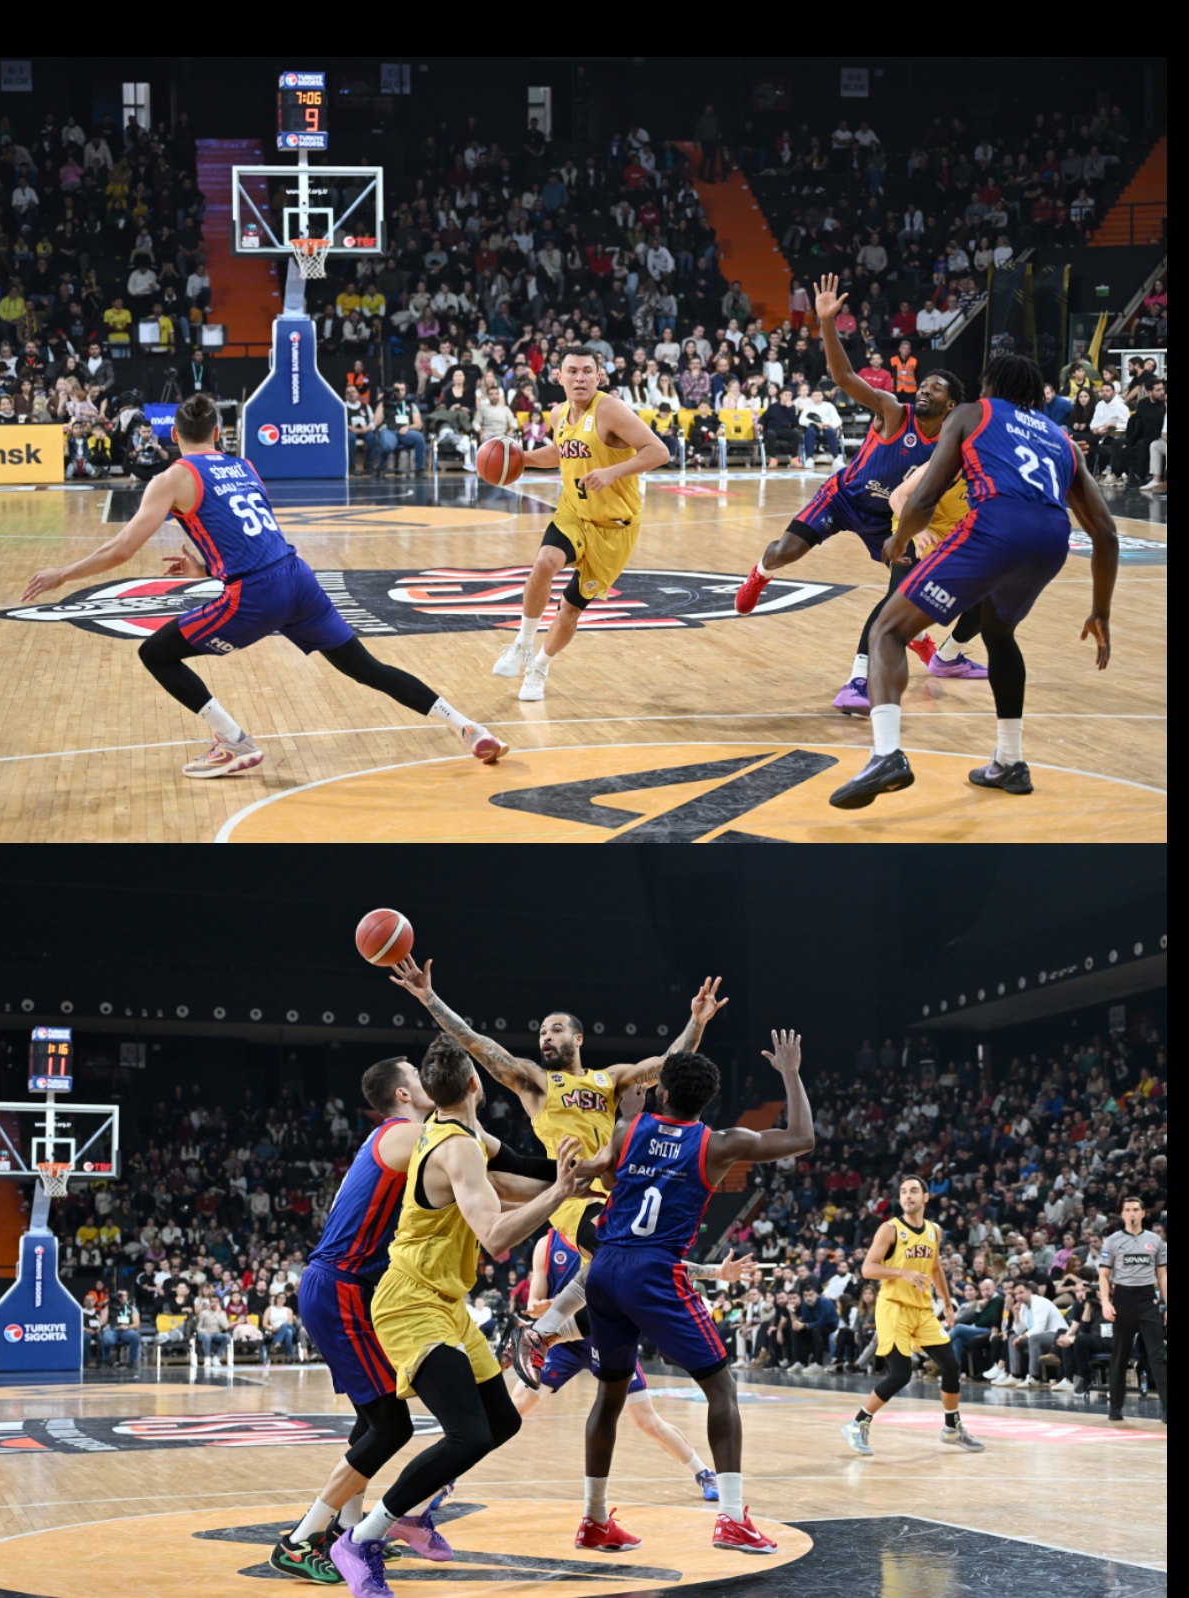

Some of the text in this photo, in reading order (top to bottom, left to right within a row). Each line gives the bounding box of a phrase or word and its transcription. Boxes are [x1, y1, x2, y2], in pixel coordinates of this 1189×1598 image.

[296, 91, 322, 105] 7:06
[305, 108, 319, 132] 9
[1005, 423, 1031, 440] BAU
[559, 439, 591, 459] MSK
[1014, 445, 1060, 501] 21
[213, 483, 237, 497] BAU
[228, 492, 278, 537] 55
[923, 580, 957, 609] HDI
[48, 1056, 66, 1076] 11
[561, 1089, 608, 1112] MSK
[648, 1138, 682, 1159] SMITH
[628, 1163, 655, 1177] BAU
[630, 1186, 662, 1237] 0
[905, 1244, 933, 1259] MSK
